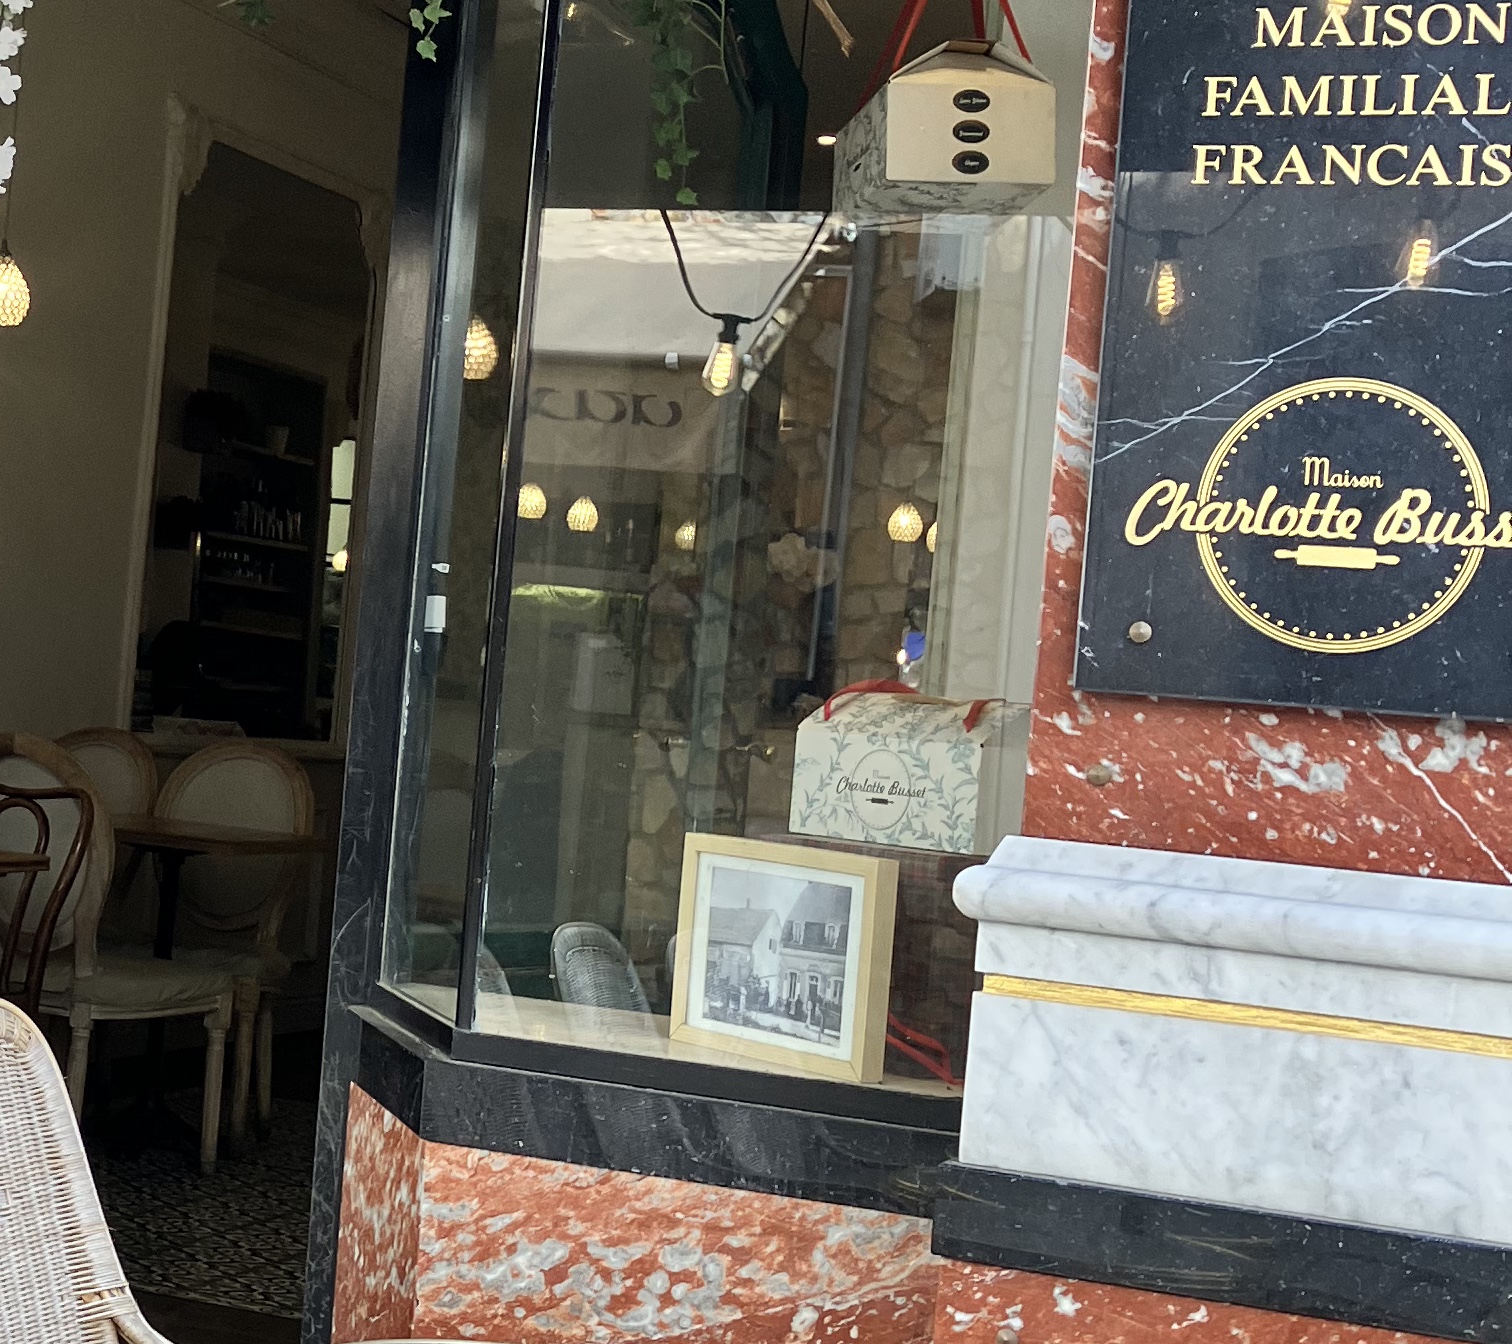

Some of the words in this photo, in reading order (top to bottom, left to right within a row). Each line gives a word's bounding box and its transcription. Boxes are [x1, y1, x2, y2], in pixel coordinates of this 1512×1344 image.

[1251, 2, 1512, 48] MAISON
[1302, 456, 1384, 489] Maison
[1124, 479, 1363, 546] Charlotte
[836, 776, 885, 794] Charlotte
[888, 781, 926, 798] Busset
